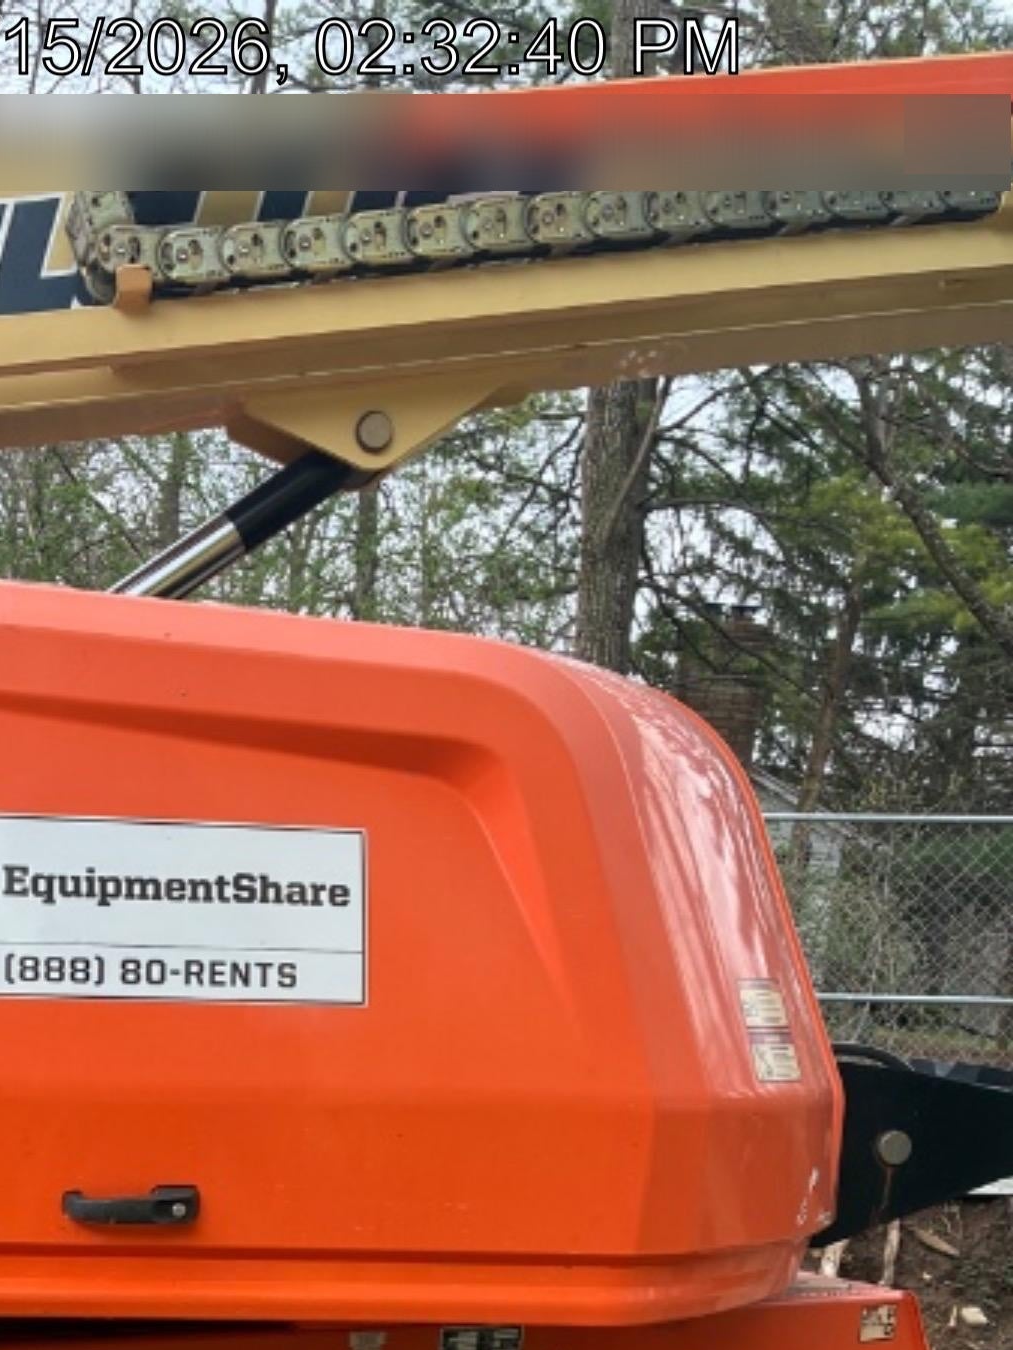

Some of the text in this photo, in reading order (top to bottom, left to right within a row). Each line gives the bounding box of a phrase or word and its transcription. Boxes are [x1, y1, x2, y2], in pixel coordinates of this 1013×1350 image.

[2, 864, 351, 907] EquipmentShare
[4, 954, 298, 989] (888) 80-RENTS
